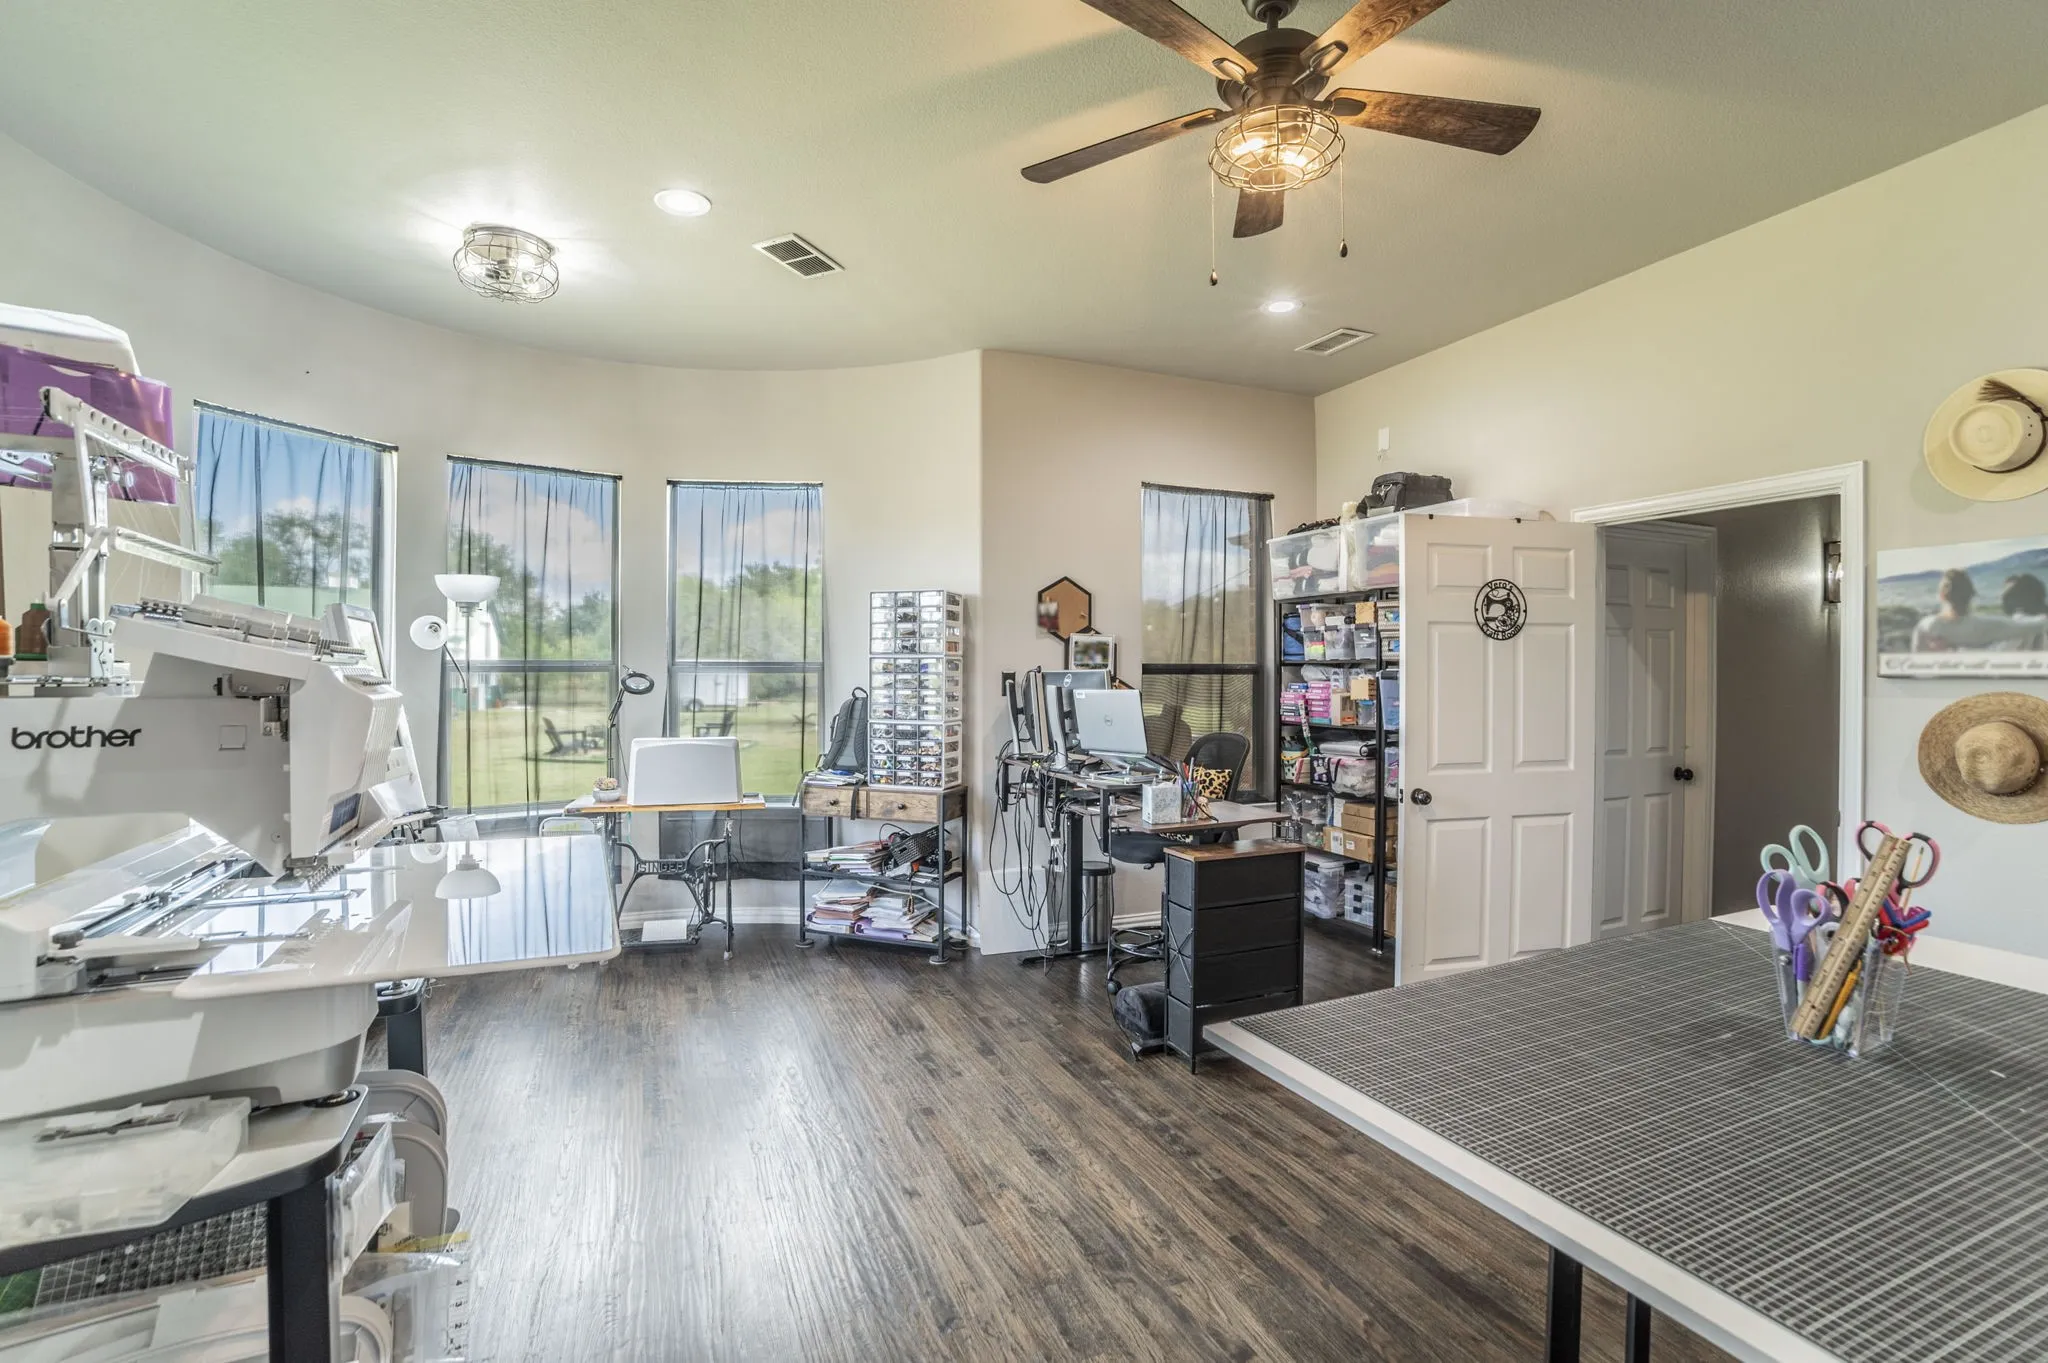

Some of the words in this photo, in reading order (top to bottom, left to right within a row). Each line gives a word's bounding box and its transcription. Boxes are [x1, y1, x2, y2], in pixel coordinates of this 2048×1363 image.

[1487, 582, 1514, 591] Vero's
[1481, 624, 1500, 639] Craft
[1502, 624, 1521, 639] Room
[11, 726, 142, 750] brother
[636, 862, 686, 873] SINGER
